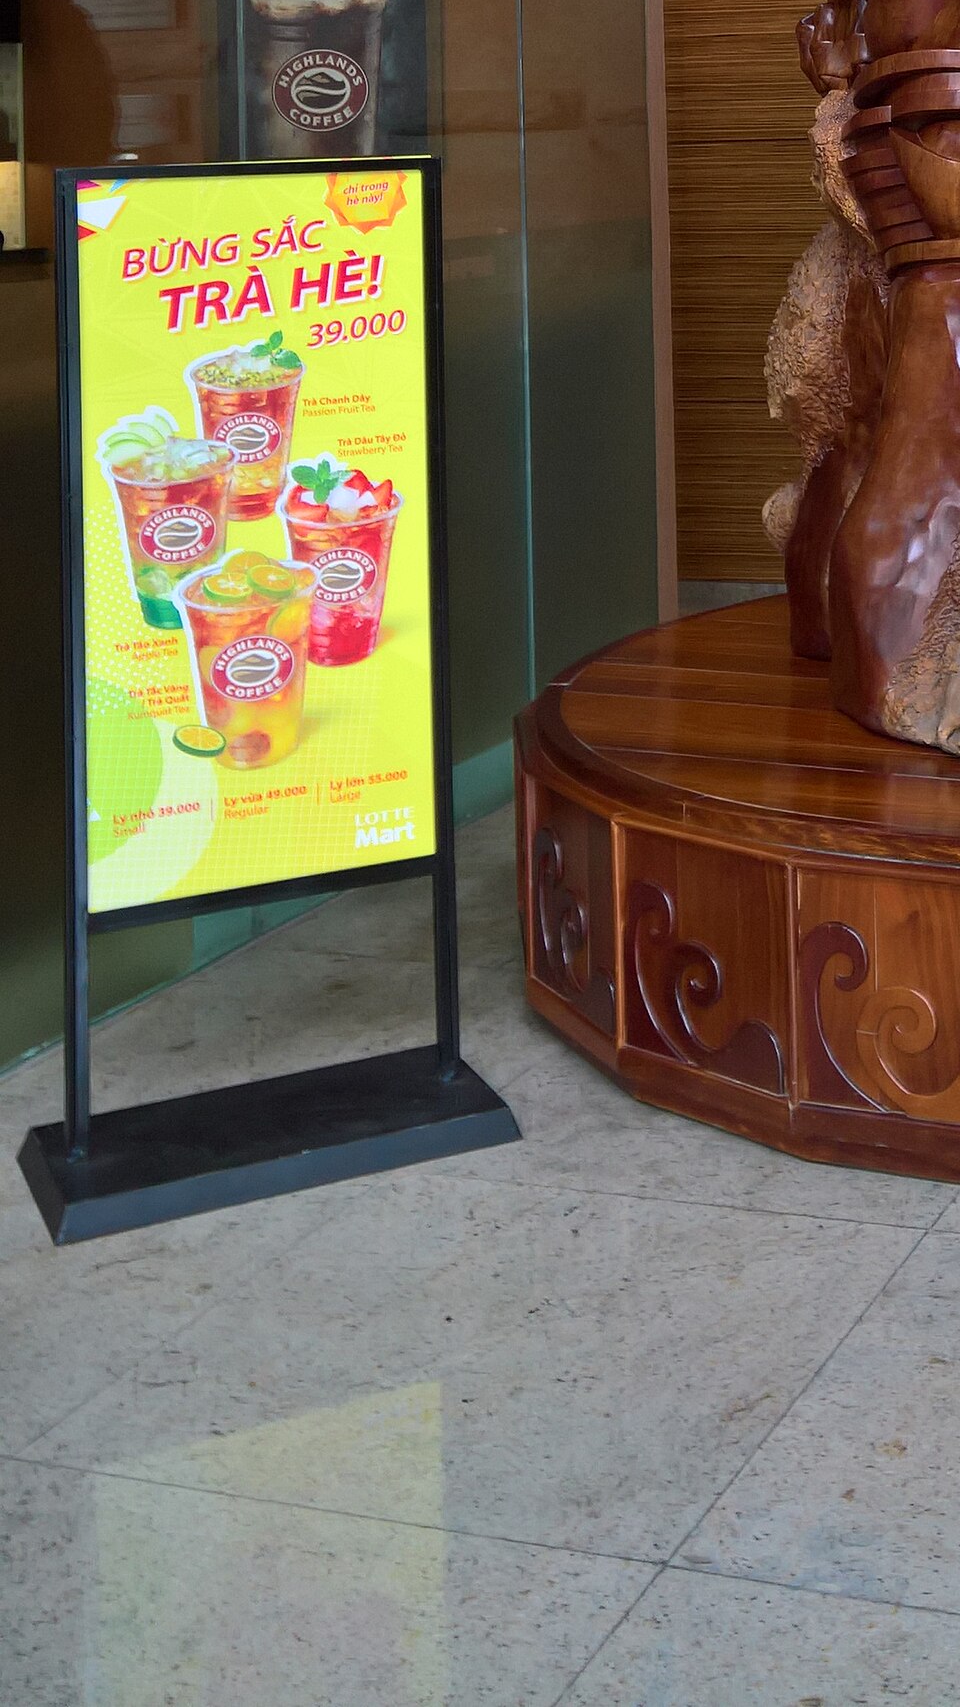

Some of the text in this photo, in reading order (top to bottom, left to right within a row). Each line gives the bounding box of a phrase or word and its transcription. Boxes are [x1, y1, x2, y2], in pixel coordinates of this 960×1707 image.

[279, 54, 363, 88] HIGHLANDS
[289, 106, 354, 127] COFFEE
[361, 181, 389, 192] trong
[121, 215, 326, 281] BỪNG SẮC
[159, 249, 384, 334] TRÀ HÈ!
[307, 309, 406, 349] 39.000
[302, 397, 317, 407] Trà
[319, 395, 350, 406] Chanh
[302, 403, 376, 417] Passion Fruit Tea
[217, 415, 279, 439] HIGHLANDS
[337, 438, 352, 447] Trà
[337, 443, 403, 457] Strawberry Tea
[143, 507, 212, 537] HIGHLANDS
[153, 542, 205, 561] COFFEE
[314, 550, 374, 572] IGHLANDS
[315, 585, 366, 602] COFFEE
[215, 638, 290, 672] HIGHLANDS
[225, 676, 283, 698] COFFEE
[330, 780, 343, 792] Ly
[224, 796, 237, 808] Ly
[224, 804, 270, 821] Regular
[113, 815, 127, 826] Ly
[354, 806, 415, 827] LOTTE
[355, 822, 416, 849] Mart
